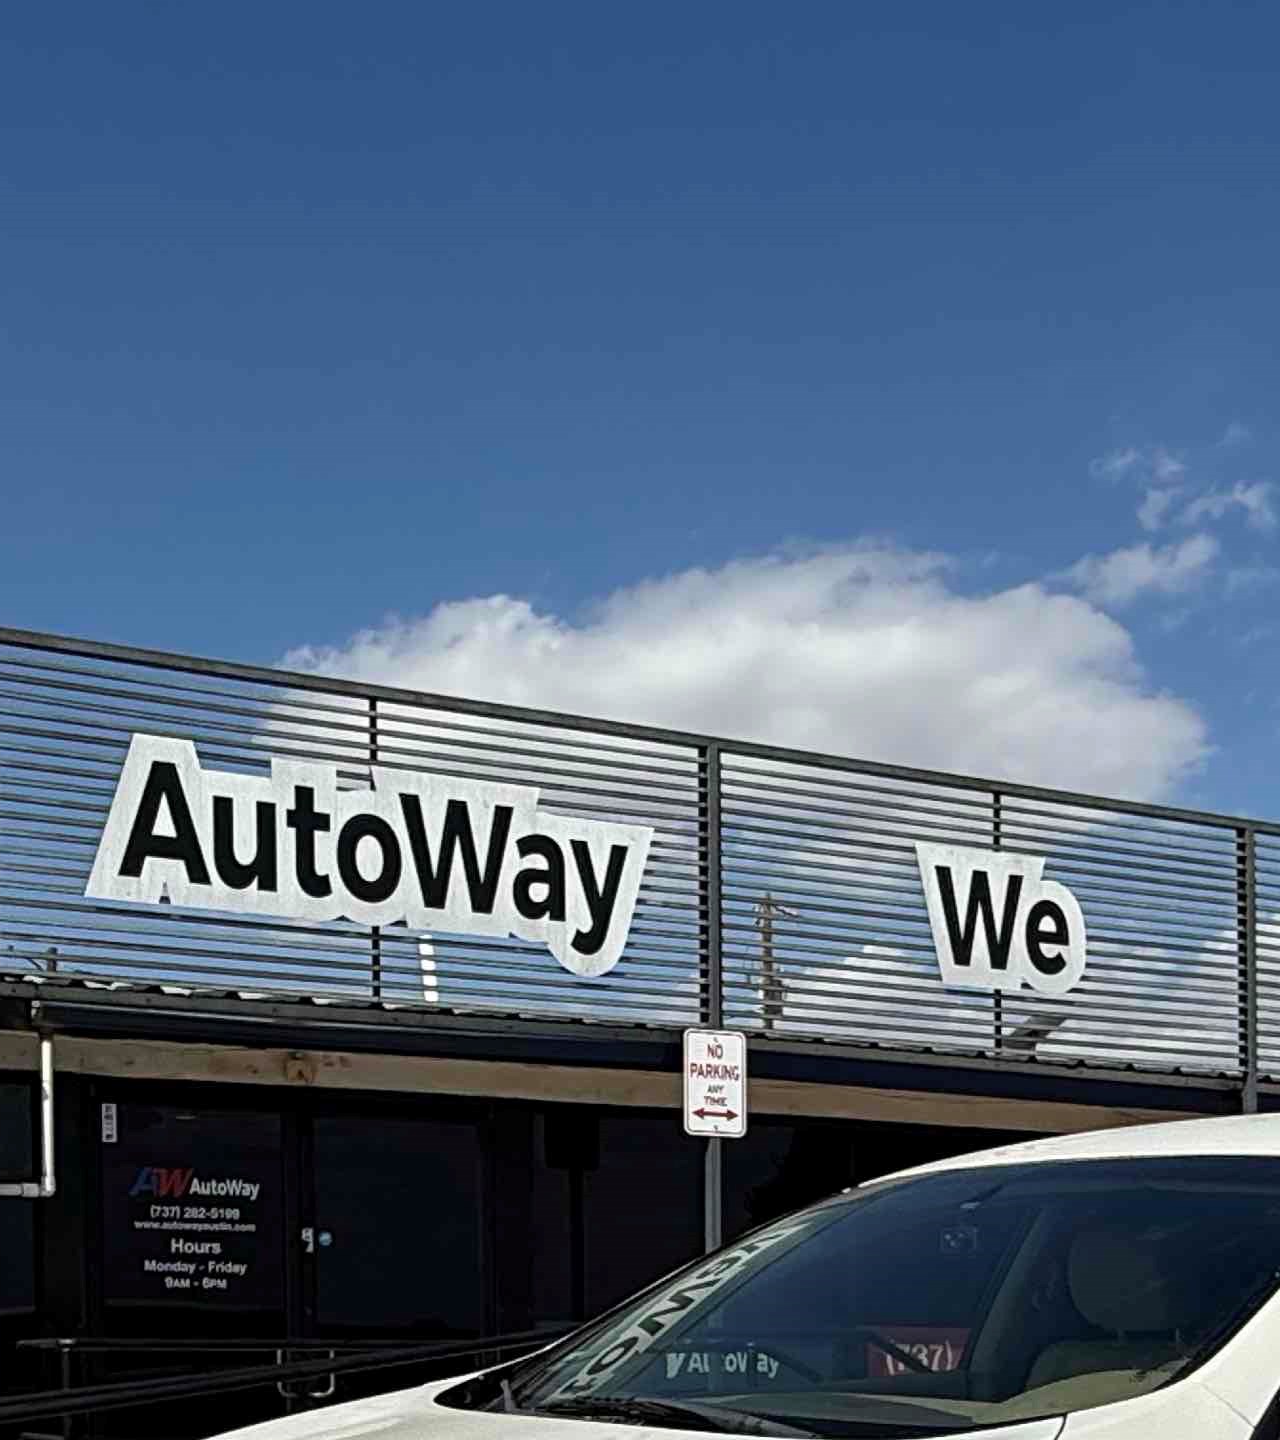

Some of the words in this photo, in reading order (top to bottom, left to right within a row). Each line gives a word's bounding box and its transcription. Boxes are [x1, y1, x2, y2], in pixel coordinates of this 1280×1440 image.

[119, 761, 628, 955] AutoWay
[937, 866, 1069, 975] We
[707, 1043, 724, 1059] NO
[690, 1062, 739, 1081] PARKING
[707, 1084, 724, 1093] ANY
[704, 1095, 728, 1106] TIME
[130, 1167, 192, 1197] AW
[189, 1178, 260, 1200] AutoWay
[150, 1204, 180, 1219] (737)
[183, 1207, 240, 1220] 282-5199
[170, 1238, 221, 1254] Hours
[144, 1260, 196, 1274] Monday
[208, 1260, 247, 1276] Friday
[164, 1277, 190, 1288] 9AM
[202, 1277, 227, 1289] 6PM
